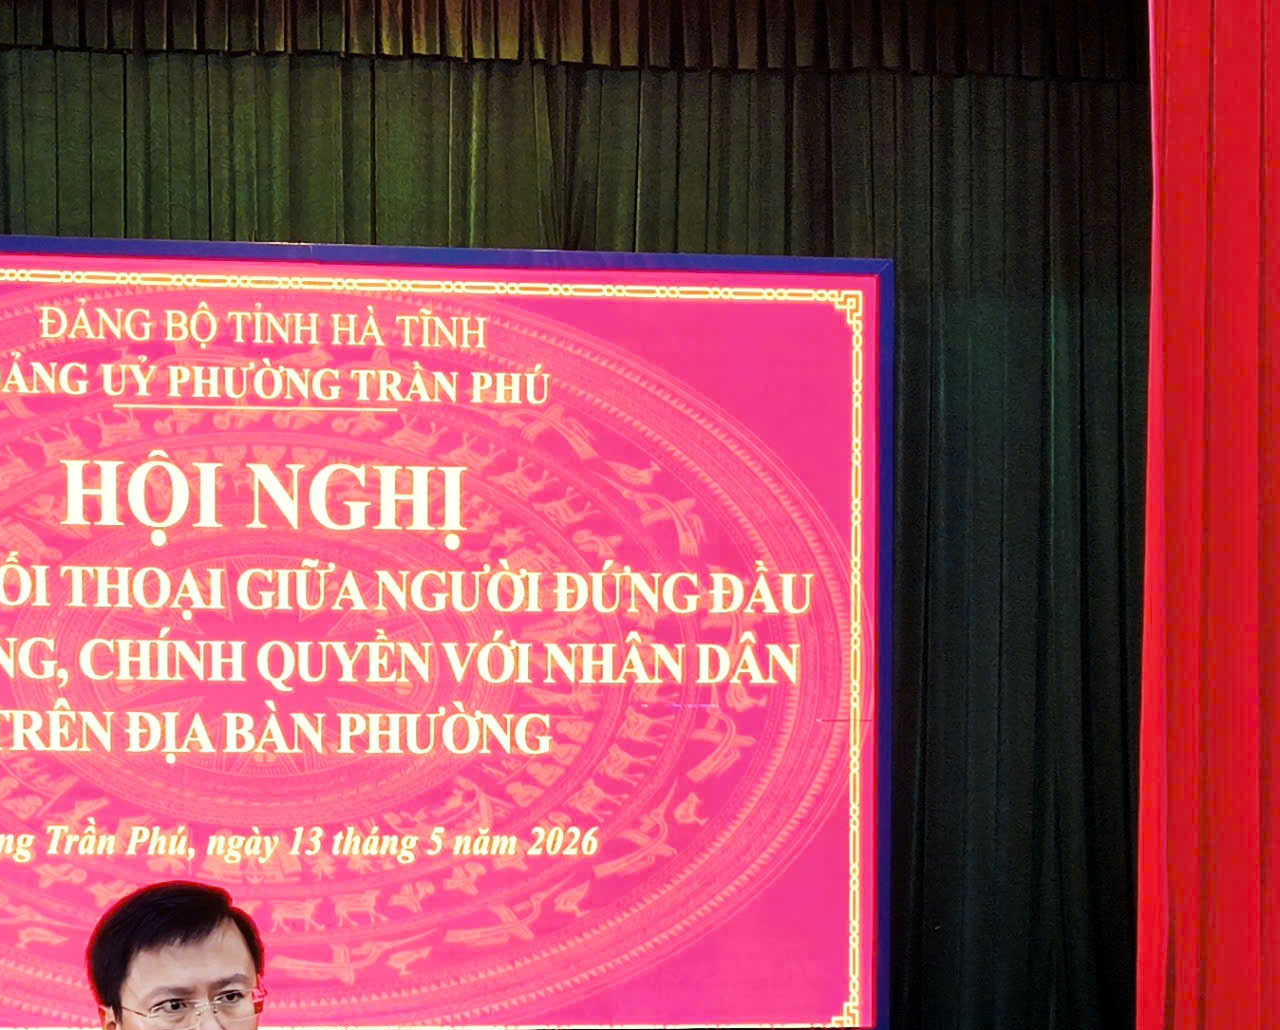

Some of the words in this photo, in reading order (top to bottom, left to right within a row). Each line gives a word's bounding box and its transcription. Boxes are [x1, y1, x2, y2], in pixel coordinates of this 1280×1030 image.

[40, 298, 152, 341] ĐẢNG
[166, 302, 217, 349] BỘ
[228, 303, 319, 344] TỈNH
[332, 306, 384, 346] HÀ
[396, 308, 486, 348] TĨNH
[102, 356, 156, 396] UỶ
[169, 358, 340, 400] PHƯỜNG
[351, 362, 458, 402] TRẦN
[472, 364, 550, 404] PHÚ
[60, 450, 223, 546] HỘI
[247, 464, 467, 550] NGHỊ
[61, 566, 224, 620] THOẠI
[237, 559, 368, 610] GIỮA
[374, 559, 541, 612] NGƯỜI
[553, 560, 700, 613] ĐỨNG
[709, 561, 813, 614] ĐẦU
[80, 627, 245, 681] CHÍNH
[258, 629, 432, 691] QUYỀN
[442, 630, 531, 683] VỚI
[544, 632, 685, 683] NHÂN
[696, 632, 800, 684] DÂN
[125, 712, 216, 763] ĐỊA
[223, 701, 325, 753] BÀN
[337, 701, 551, 754] PHƯỜNG
[47, 818, 116, 855] Trần
[126, 826, 195, 860] Phú,
[207, 827, 279, 864] ngày
[289, 827, 323, 856] 13
[333, 826, 419, 864] tháng
[427, 827, 444, 855] 5
[454, 827, 517, 855] năm
[527, 827, 597, 855] 2026
